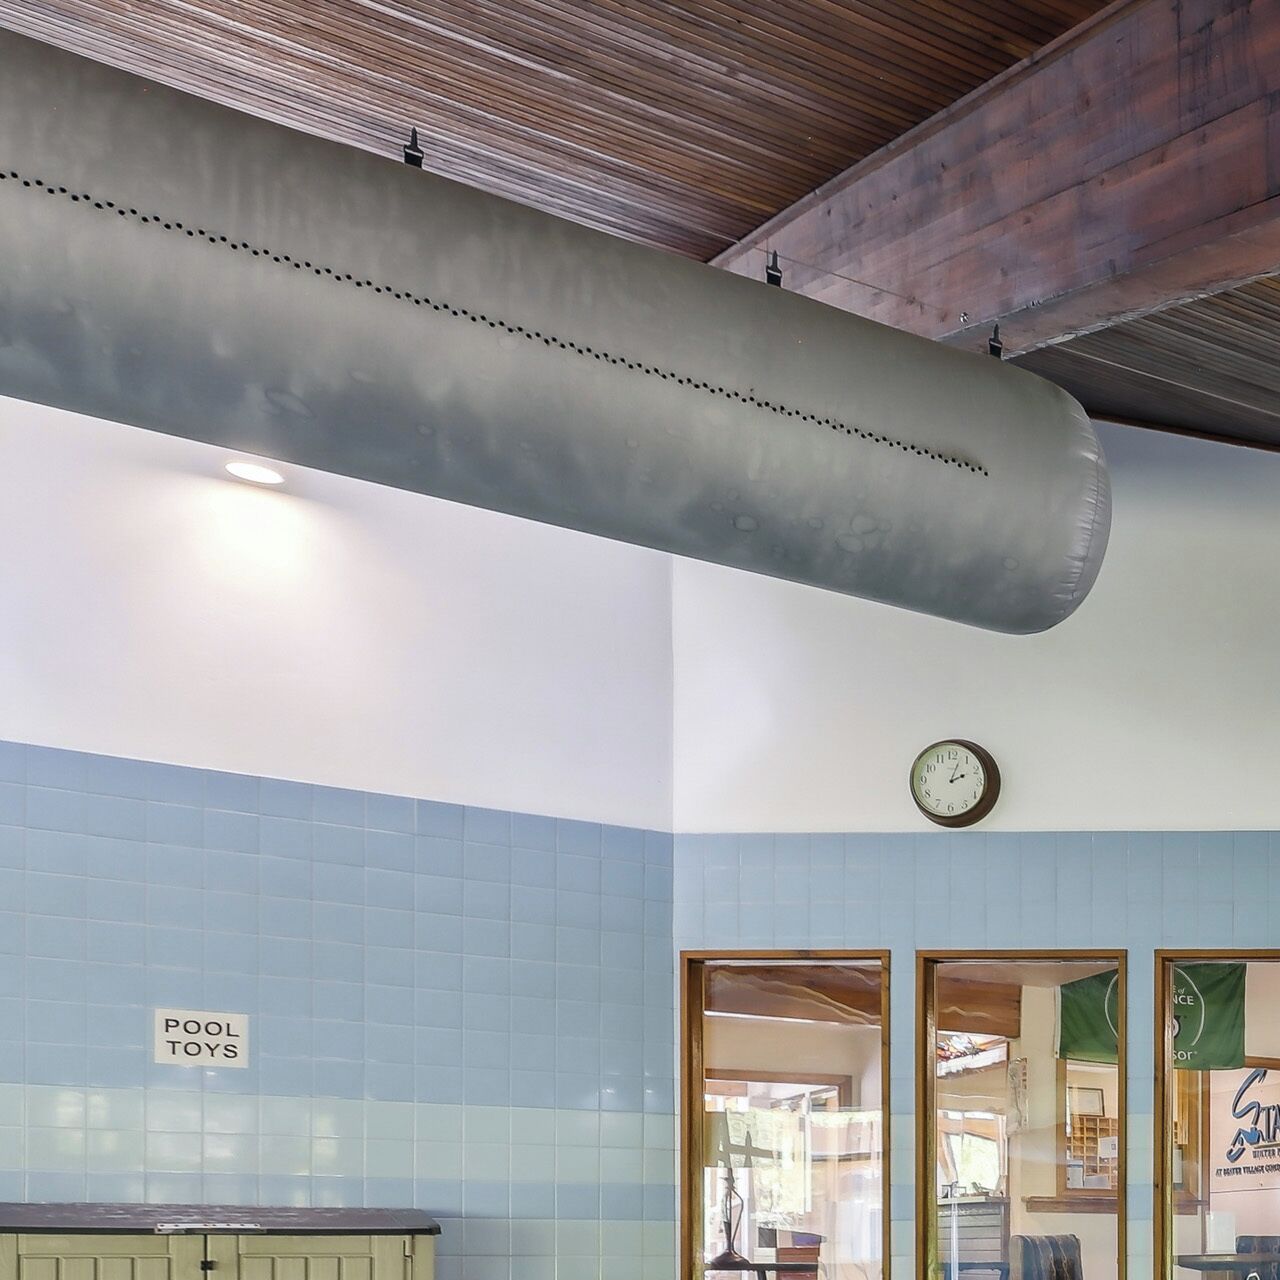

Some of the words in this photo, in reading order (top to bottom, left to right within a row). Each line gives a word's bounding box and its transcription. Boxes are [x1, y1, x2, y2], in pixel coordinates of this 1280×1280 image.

[936, 754, 944, 763] 11
[947, 751, 958, 760] 12
[926, 764, 936, 773] 10
[165, 1018, 240, 1037] POOL
[166, 1040, 238, 1059] TOYS
